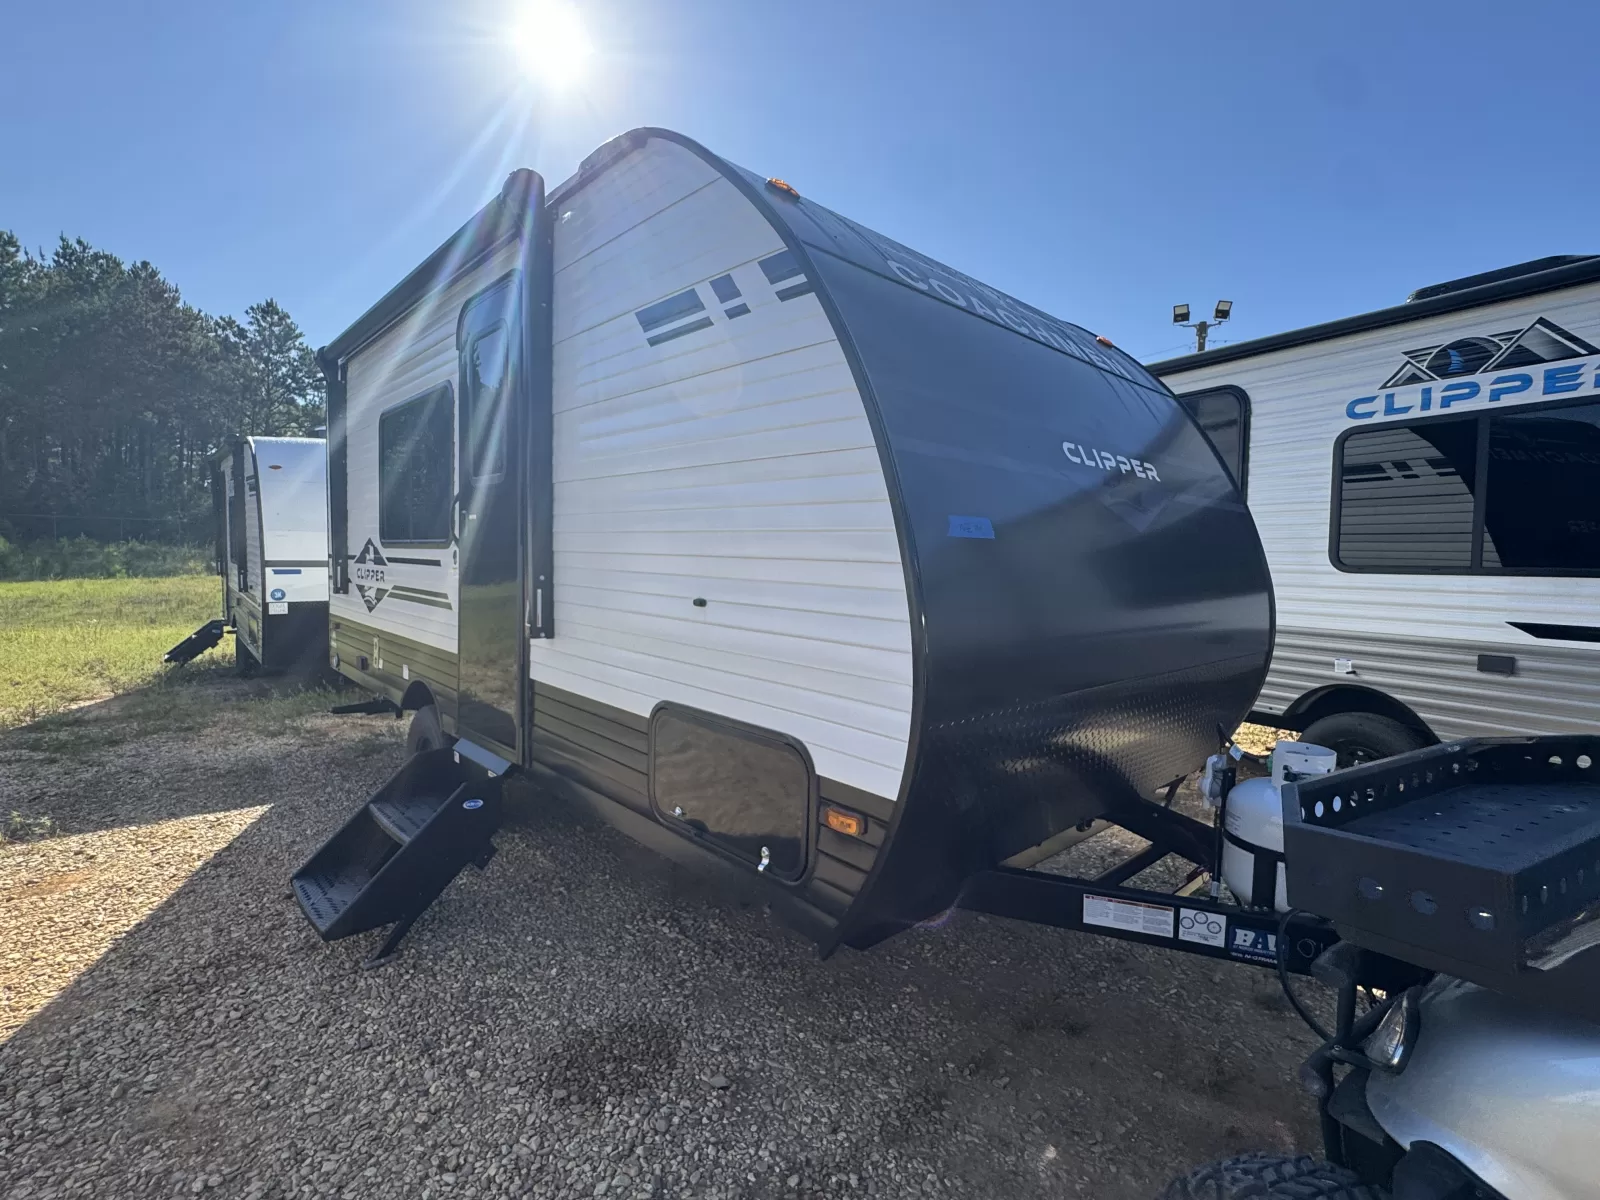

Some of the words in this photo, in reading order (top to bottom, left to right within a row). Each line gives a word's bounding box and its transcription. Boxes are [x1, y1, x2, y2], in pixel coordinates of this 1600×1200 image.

[887, 259, 1134, 380] COACHMEN
[1062, 441, 1161, 482] CLIPPER
[356, 567, 385, 583] CLIPPER
